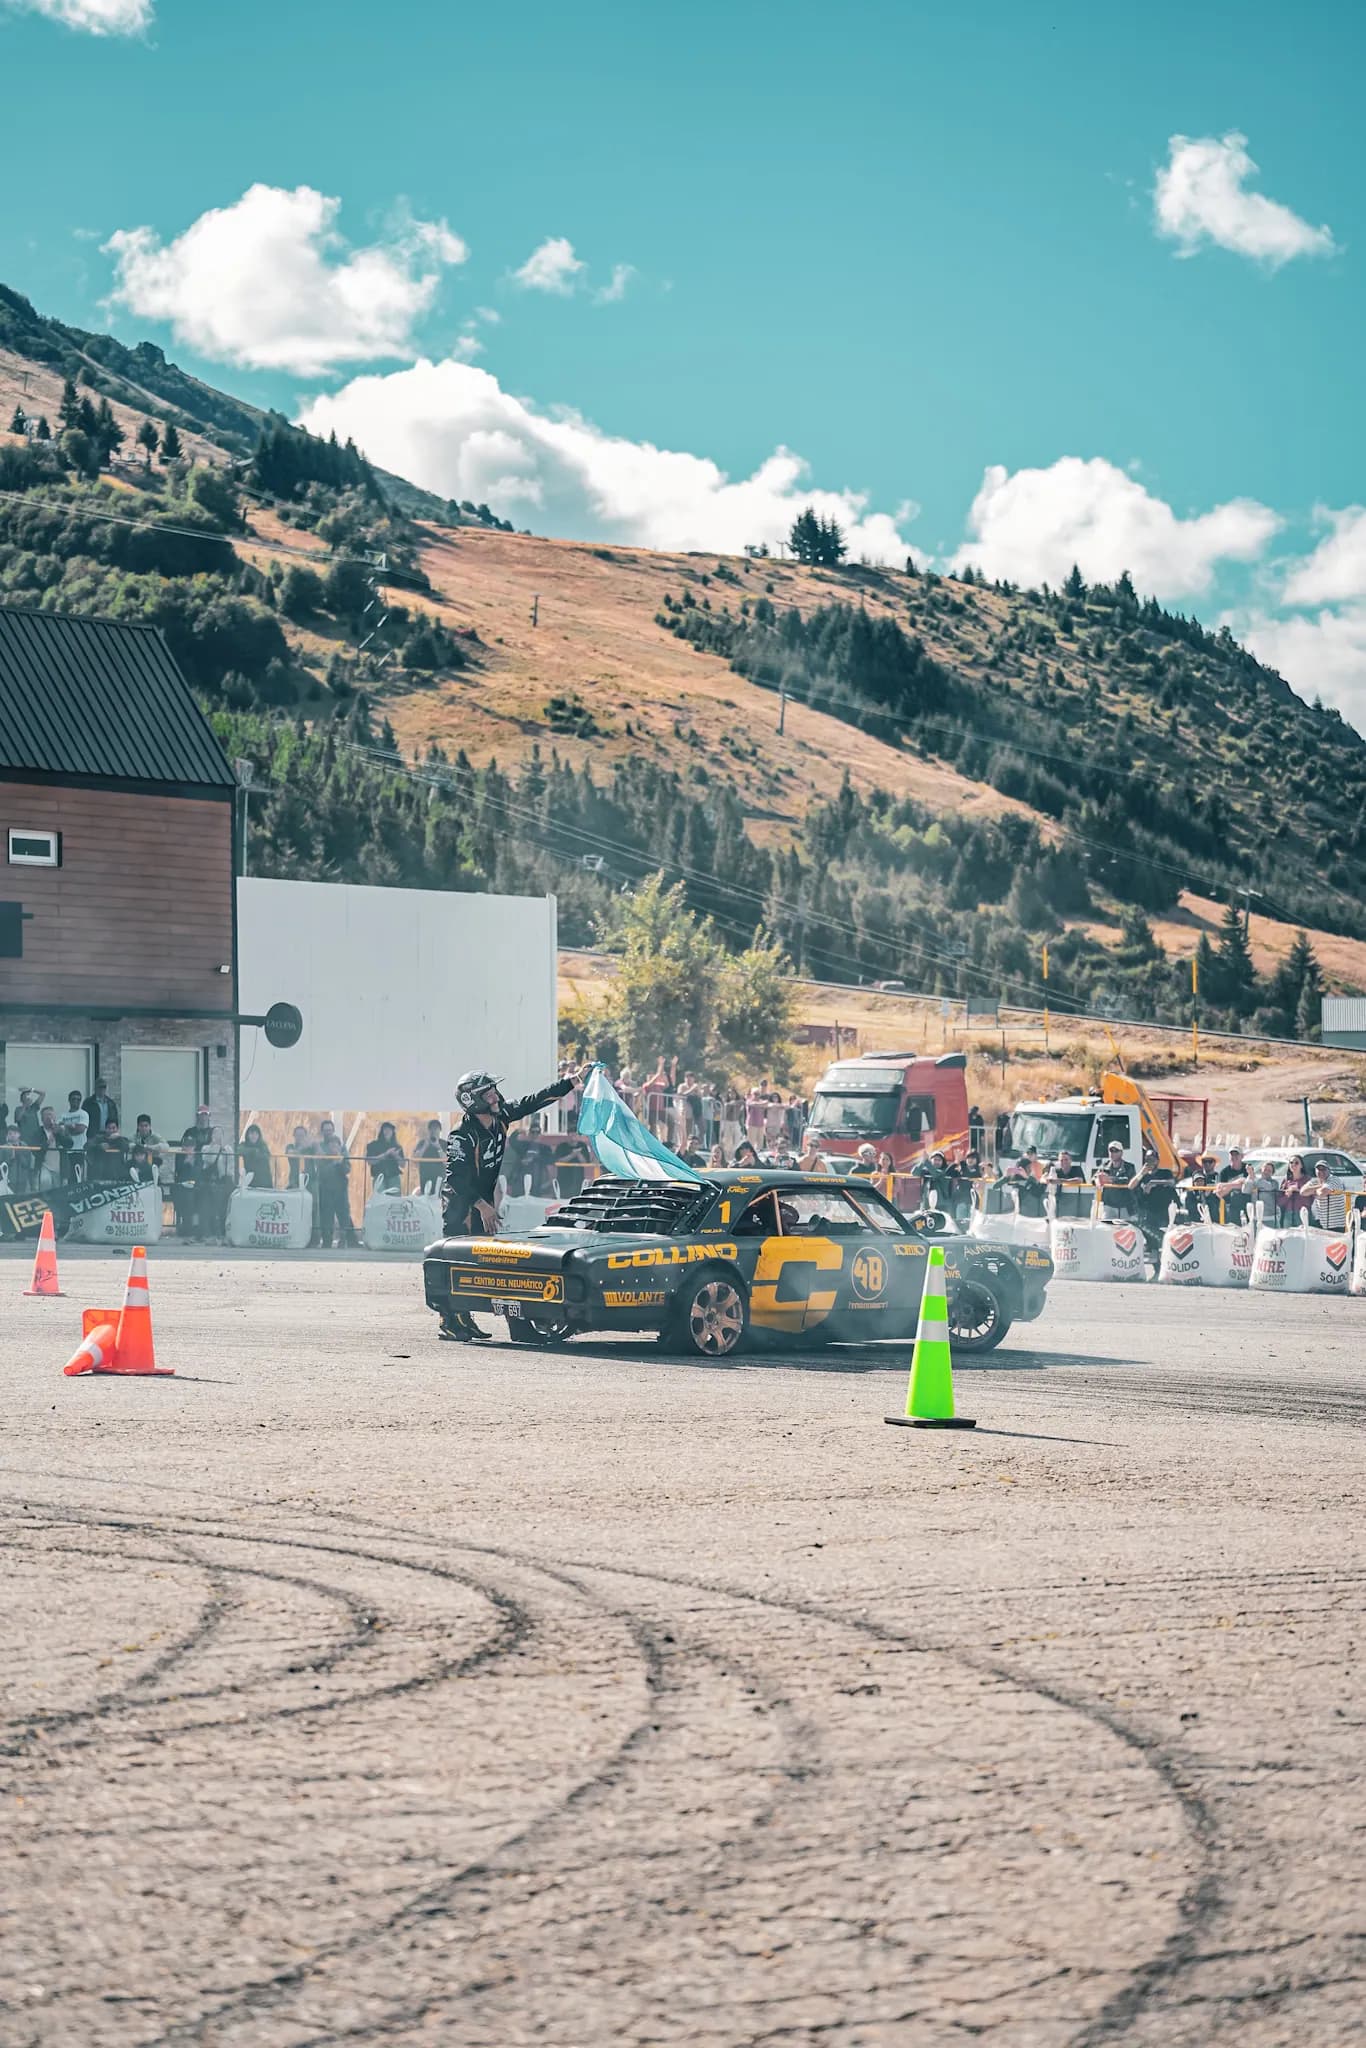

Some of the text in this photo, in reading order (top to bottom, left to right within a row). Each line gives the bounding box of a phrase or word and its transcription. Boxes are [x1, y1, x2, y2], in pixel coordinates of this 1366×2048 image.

[110, 1211, 145, 1224] NIRE
[718, 1200, 731, 1224] 1
[255, 1220, 289, 1235] NIRE
[386, 1219, 421, 1233] NIRE
[607, 1242, 738, 1269] COLLINO
[853, 1256, 882, 1291] 48
[473, 1276, 496, 1287] CENTRO
[496, 1278, 507, 1288] DEL
[508, 1278, 543, 1290] NEUMÁTICO
[616, 1291, 665, 1304] VOLANTE
